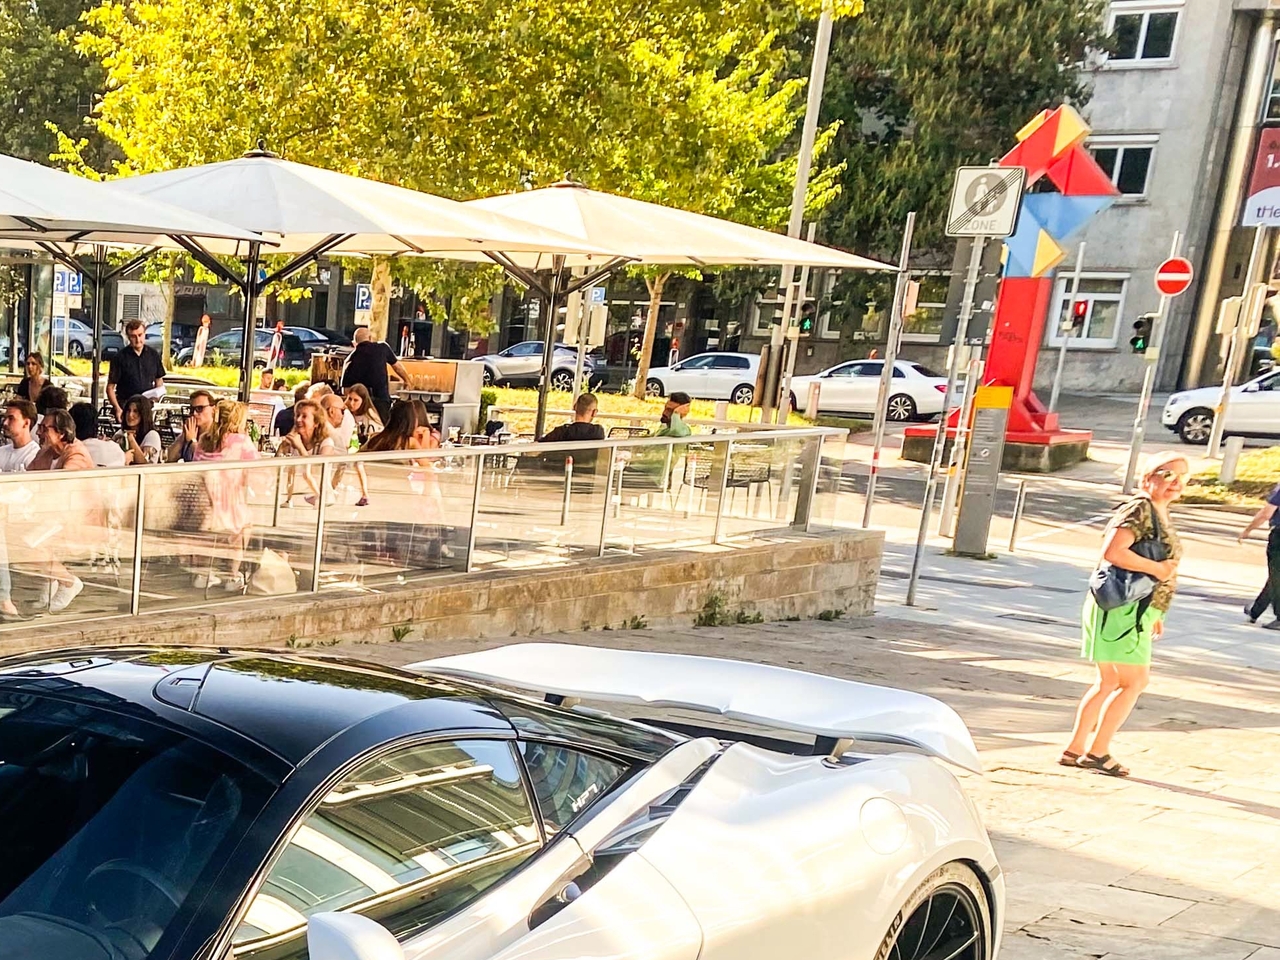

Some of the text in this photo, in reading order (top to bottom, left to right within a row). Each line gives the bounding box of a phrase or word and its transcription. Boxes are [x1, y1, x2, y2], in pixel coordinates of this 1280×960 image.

[964, 219, 997, 231] ZONE
[70, 272, 79, 292] P
[358, 286, 369, 308] P
[592, 289, 601, 302] P
